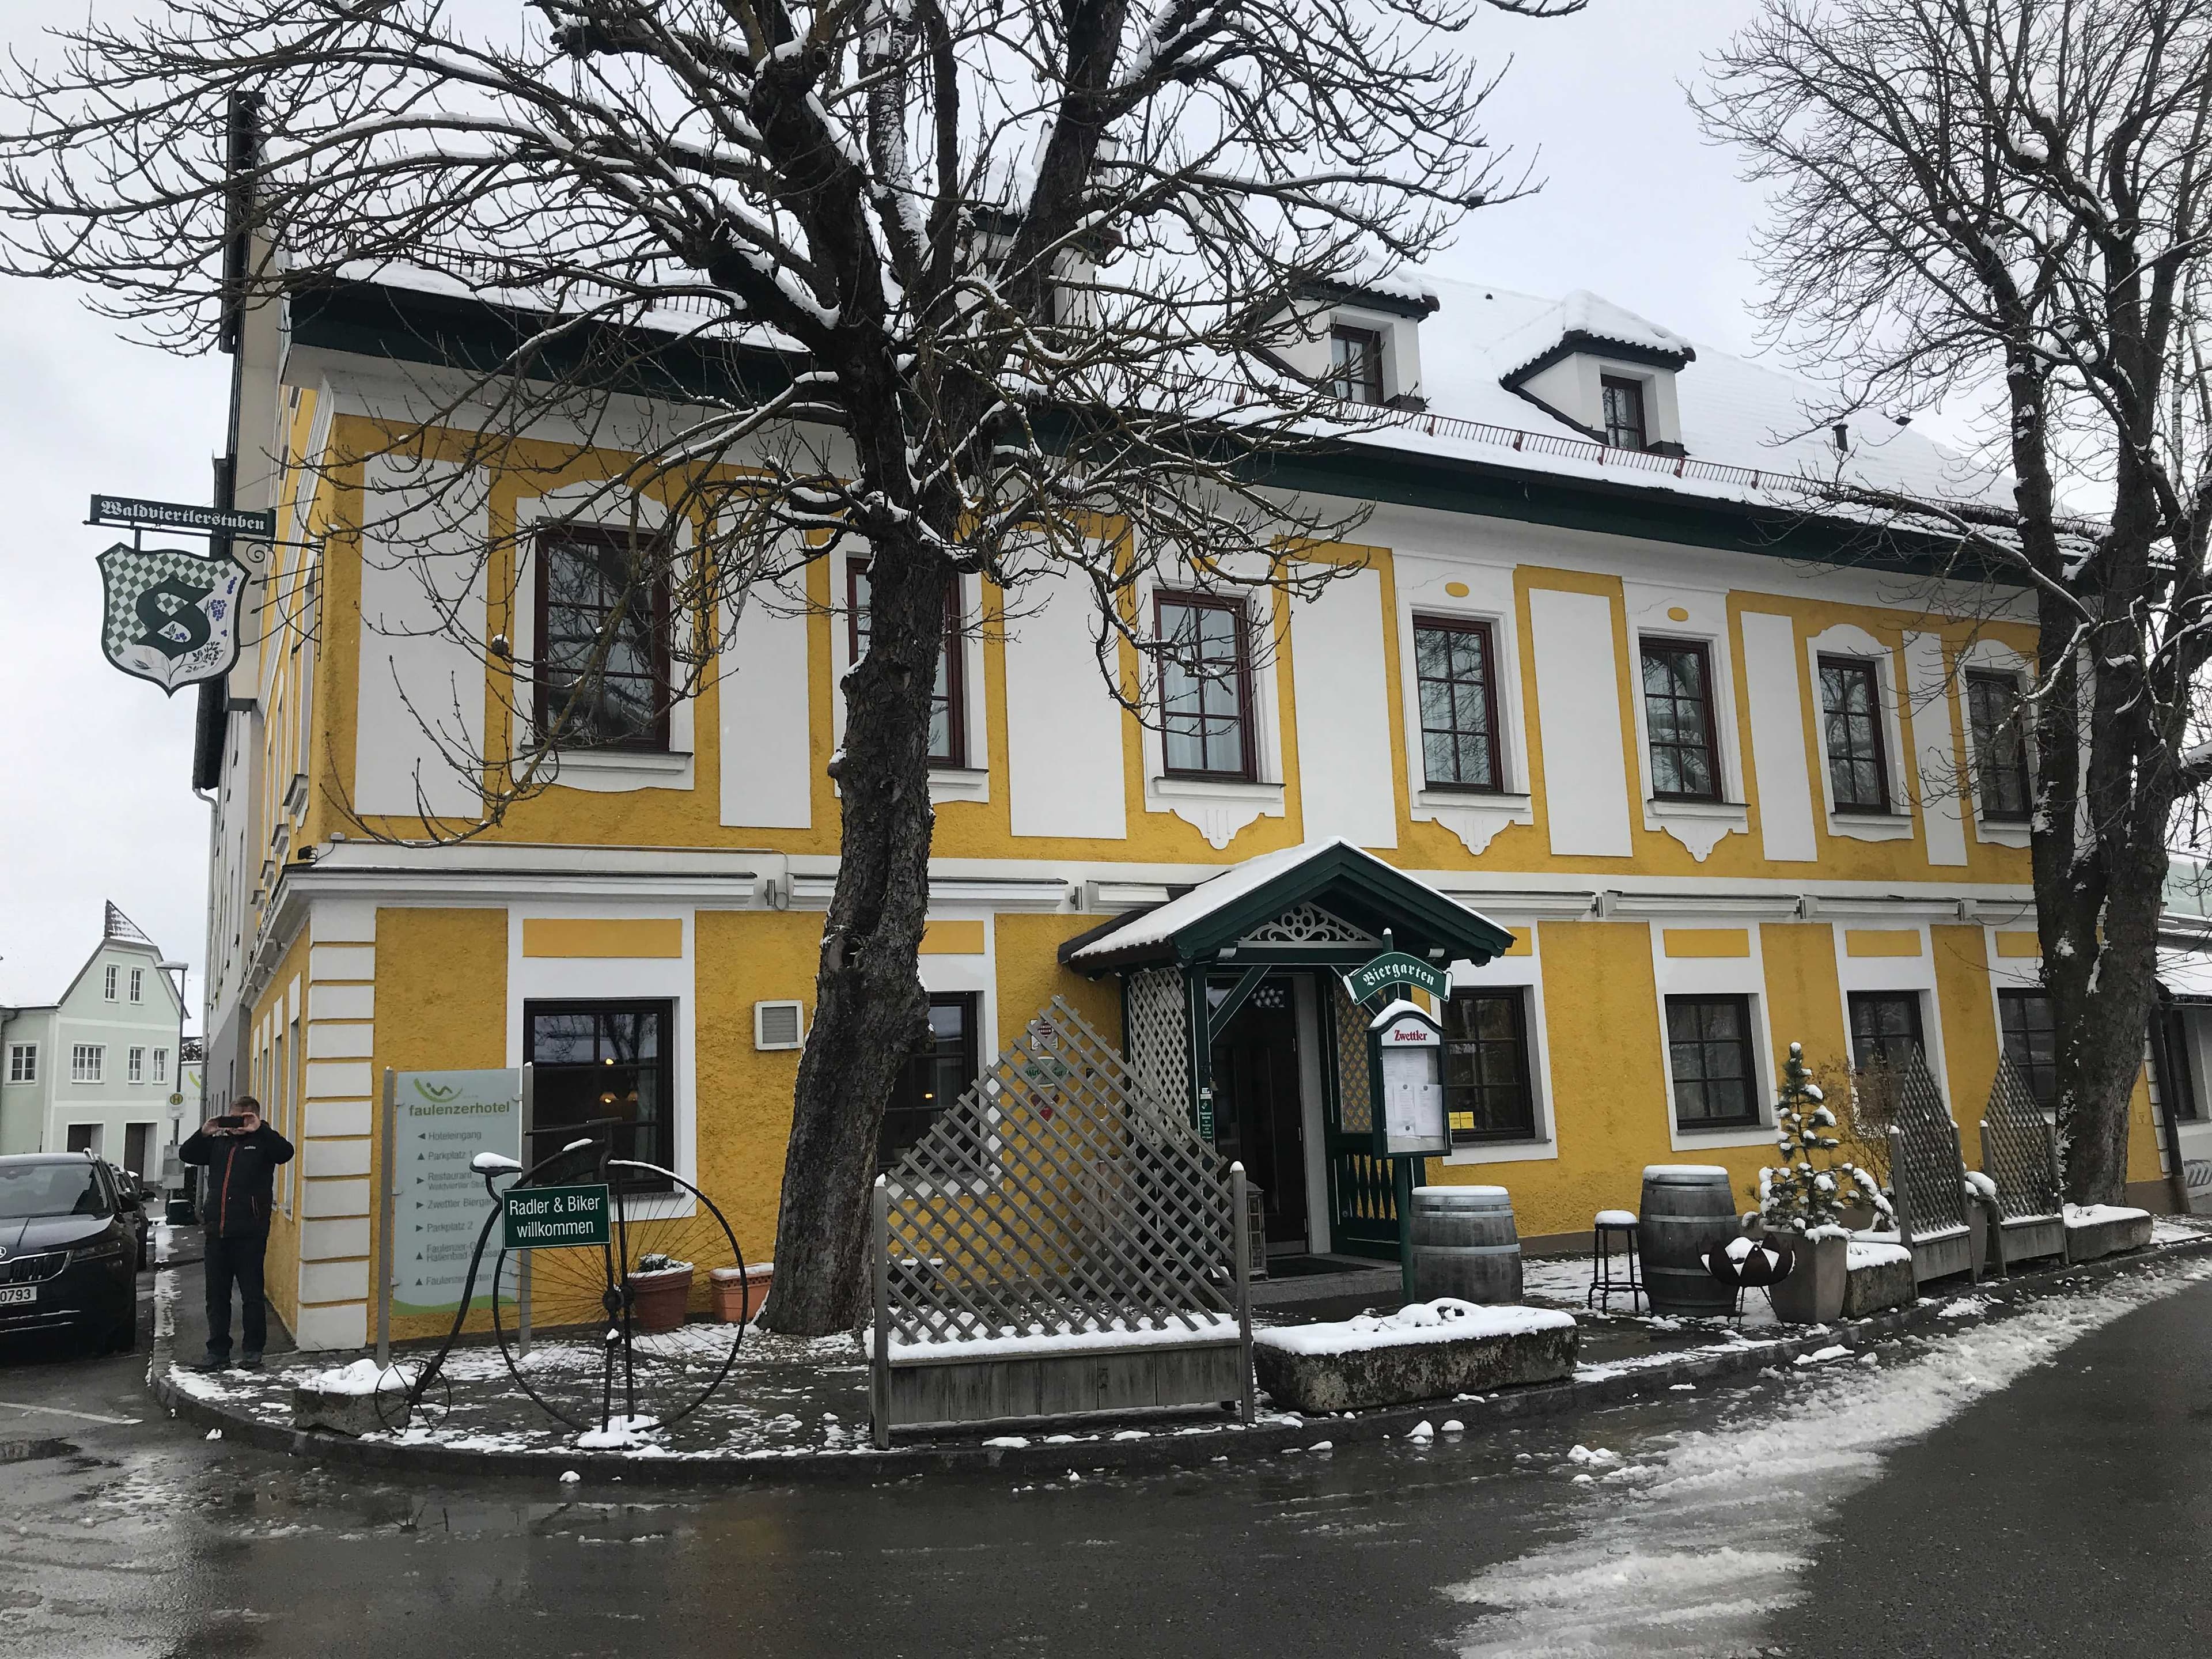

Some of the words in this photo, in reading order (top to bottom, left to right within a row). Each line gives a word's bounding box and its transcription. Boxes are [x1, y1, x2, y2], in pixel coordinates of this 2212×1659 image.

[1362, 963, 1434, 986] Biergarten
[1394, 1029, 1427, 1041] Zwettler
[409, 1101, 510, 1116] faulenzerhotel
[428, 1131, 482, 1141] Hoteleingang
[428, 1151, 466, 1161] Parkplatz
[428, 1171, 472, 1180] Restaurant
[427, 1199, 461, 1209] Zwettler
[509, 1198, 550, 1216] Radler
[554, 1197, 564, 1213] &
[567, 1195, 600, 1212] Biker
[427, 1222, 465, 1233] Parkplatz
[467, 1221, 474, 1230] 2
[517, 1221, 594, 1238] willkommen
[1, 1288, 31, 1302] 0793
